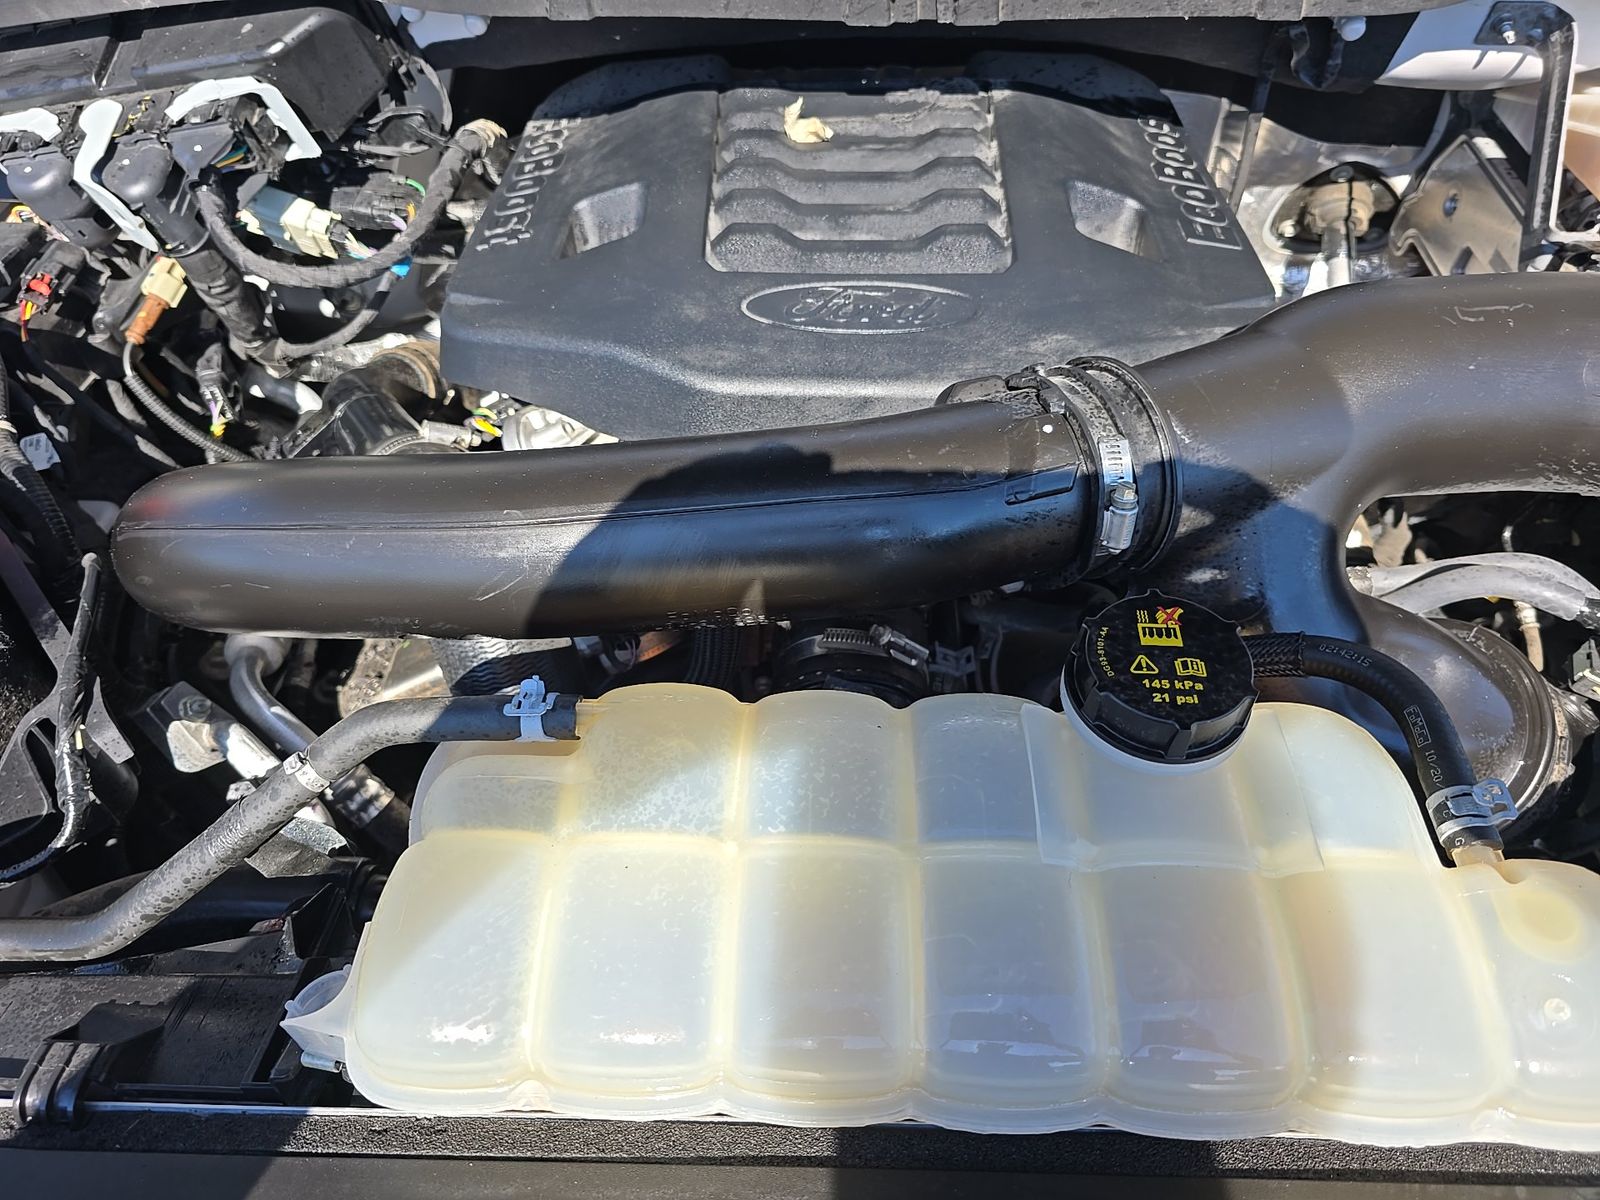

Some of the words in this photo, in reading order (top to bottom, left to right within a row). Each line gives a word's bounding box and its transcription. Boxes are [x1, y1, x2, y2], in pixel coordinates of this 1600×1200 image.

[1137, 117, 1243, 251] ECOBOOS
[783, 286, 941, 325] Ford
[1142, 678, 1171, 689] 145
[1175, 679, 1204, 691] kPa
[1152, 692, 1170, 703] 21
[1176, 694, 1199, 705] psi
